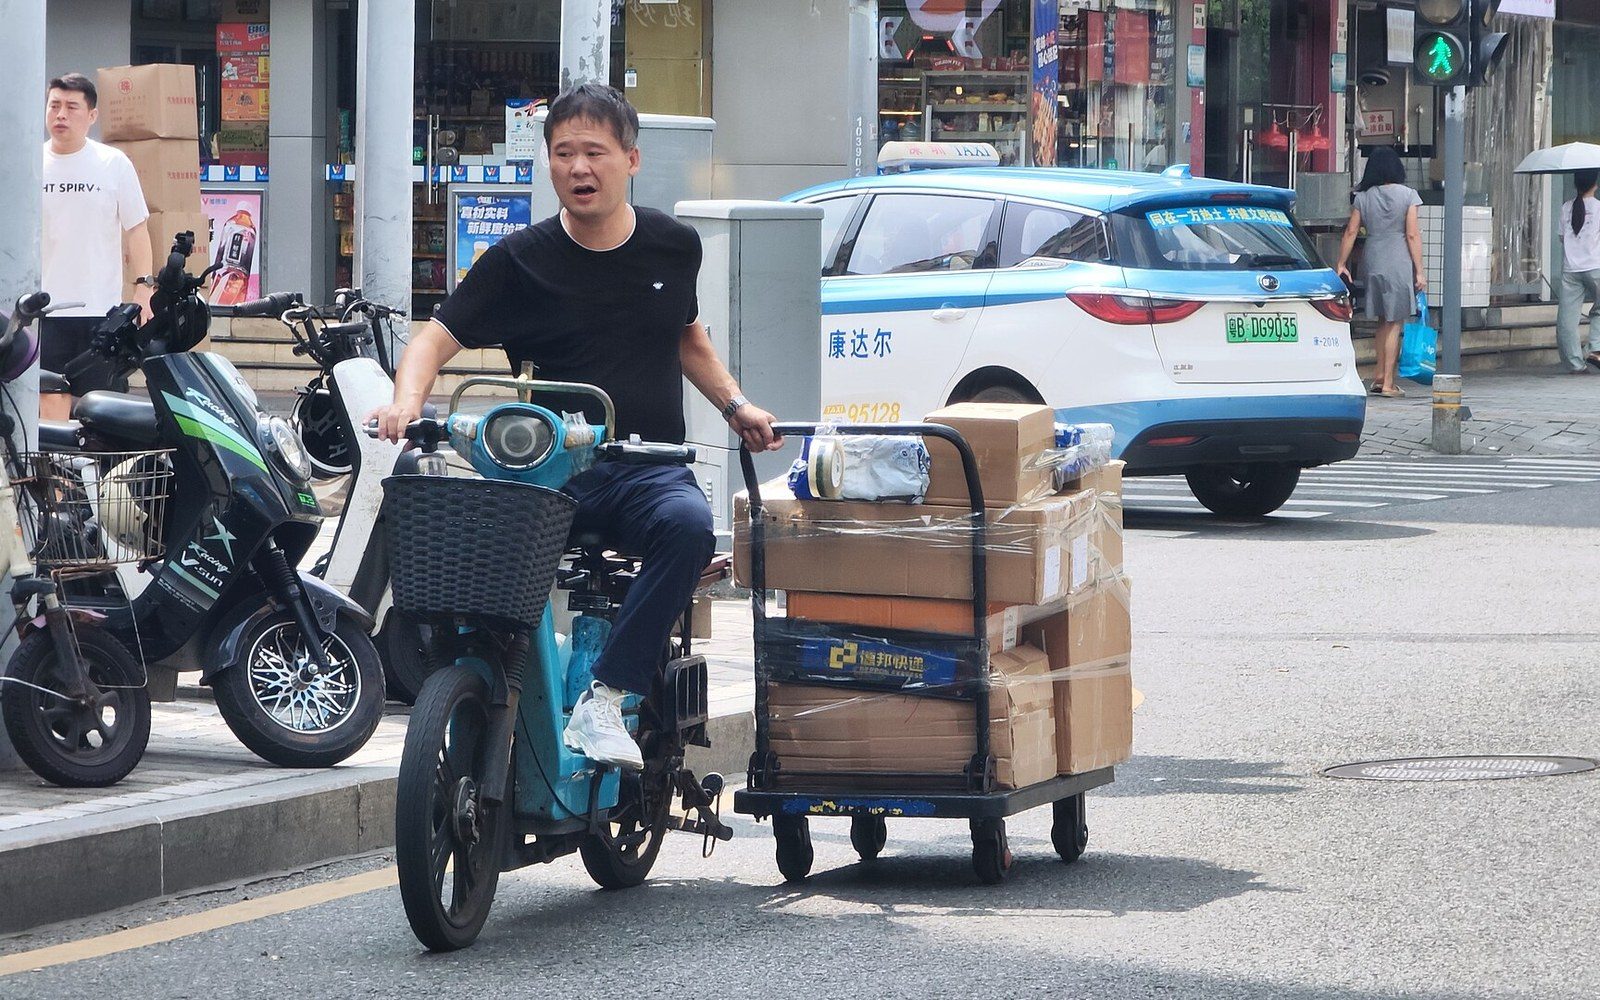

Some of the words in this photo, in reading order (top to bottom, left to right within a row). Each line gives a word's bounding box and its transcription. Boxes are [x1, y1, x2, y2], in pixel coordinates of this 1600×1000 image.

[1251, 316, 1298, 338] DG9035
[828, 327, 893, 359] 康达尔
[185, 386, 239, 428] Racing
[847, 402, 901, 424] 95128
[187, 540, 232, 574] Racing
[859, 649, 924, 672] 德邦快递
